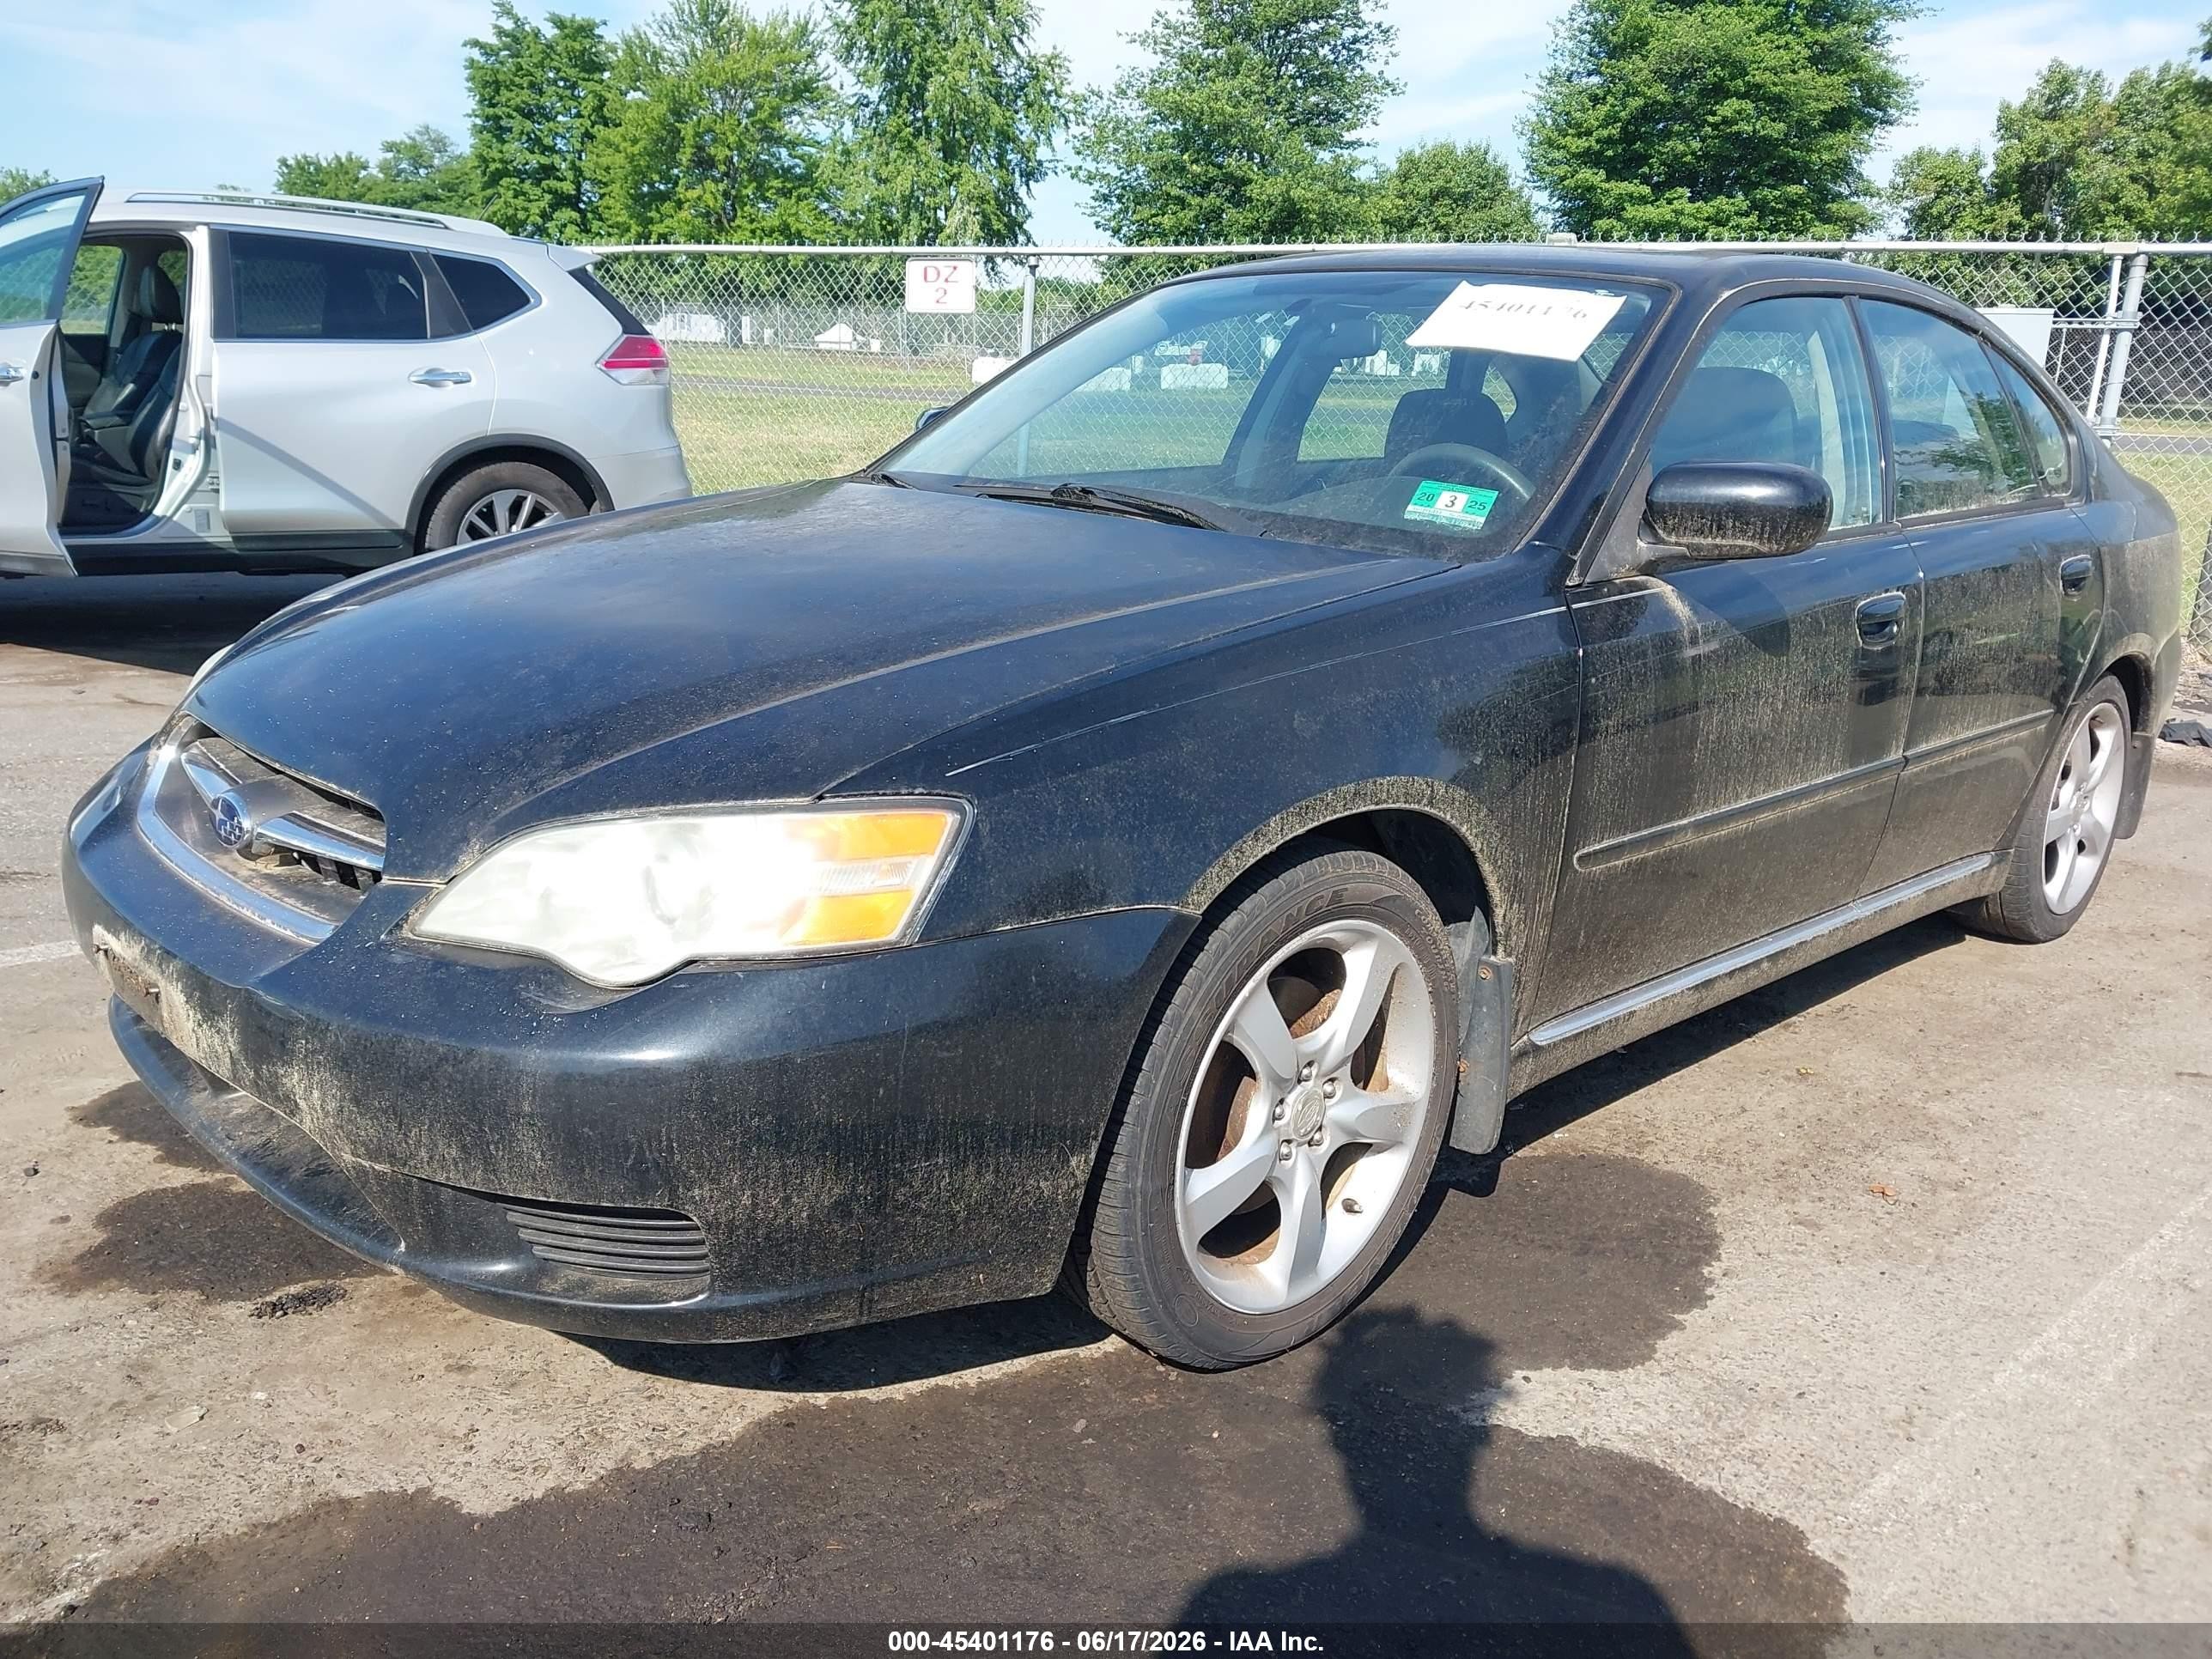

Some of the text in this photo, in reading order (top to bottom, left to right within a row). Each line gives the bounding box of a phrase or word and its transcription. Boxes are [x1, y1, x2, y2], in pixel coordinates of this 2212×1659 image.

[923, 265, 959, 283] DZ
[935, 287, 948, 304] 2
[1417, 492, 1487, 511] 20 3 25
